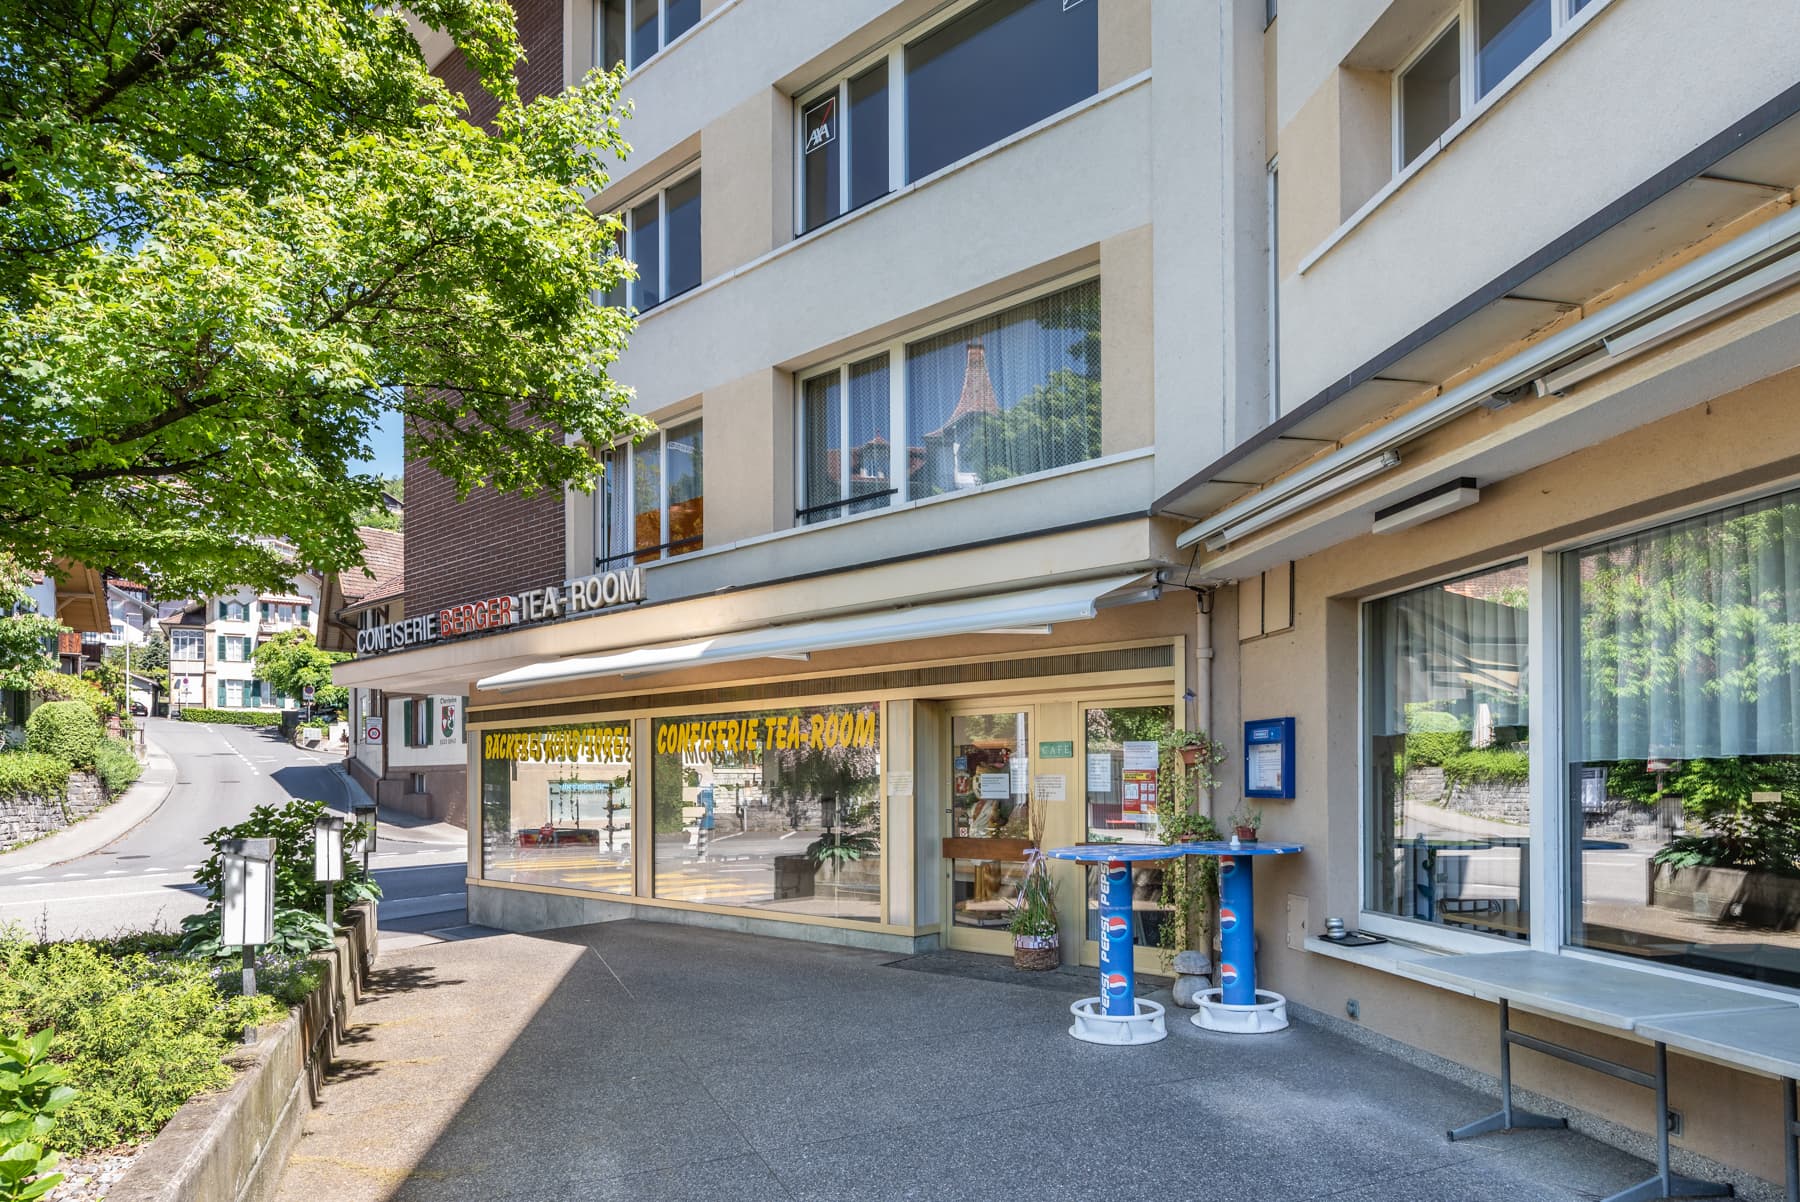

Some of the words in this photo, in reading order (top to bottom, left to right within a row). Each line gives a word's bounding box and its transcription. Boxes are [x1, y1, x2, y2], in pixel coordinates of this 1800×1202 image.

[806, 123, 830, 149] AXA
[356, 613, 437, 653] CONFISERIE
[440, 596, 513, 637] BERGER
[485, 732, 542, 761] BÄCKEREI
[545, 726, 629, 760] KONDITOREI
[657, 719, 759, 755] CONFISERIE
[765, 711, 876, 751] TEA-ROOM
[1100, 915, 1110, 963] PEPSI
